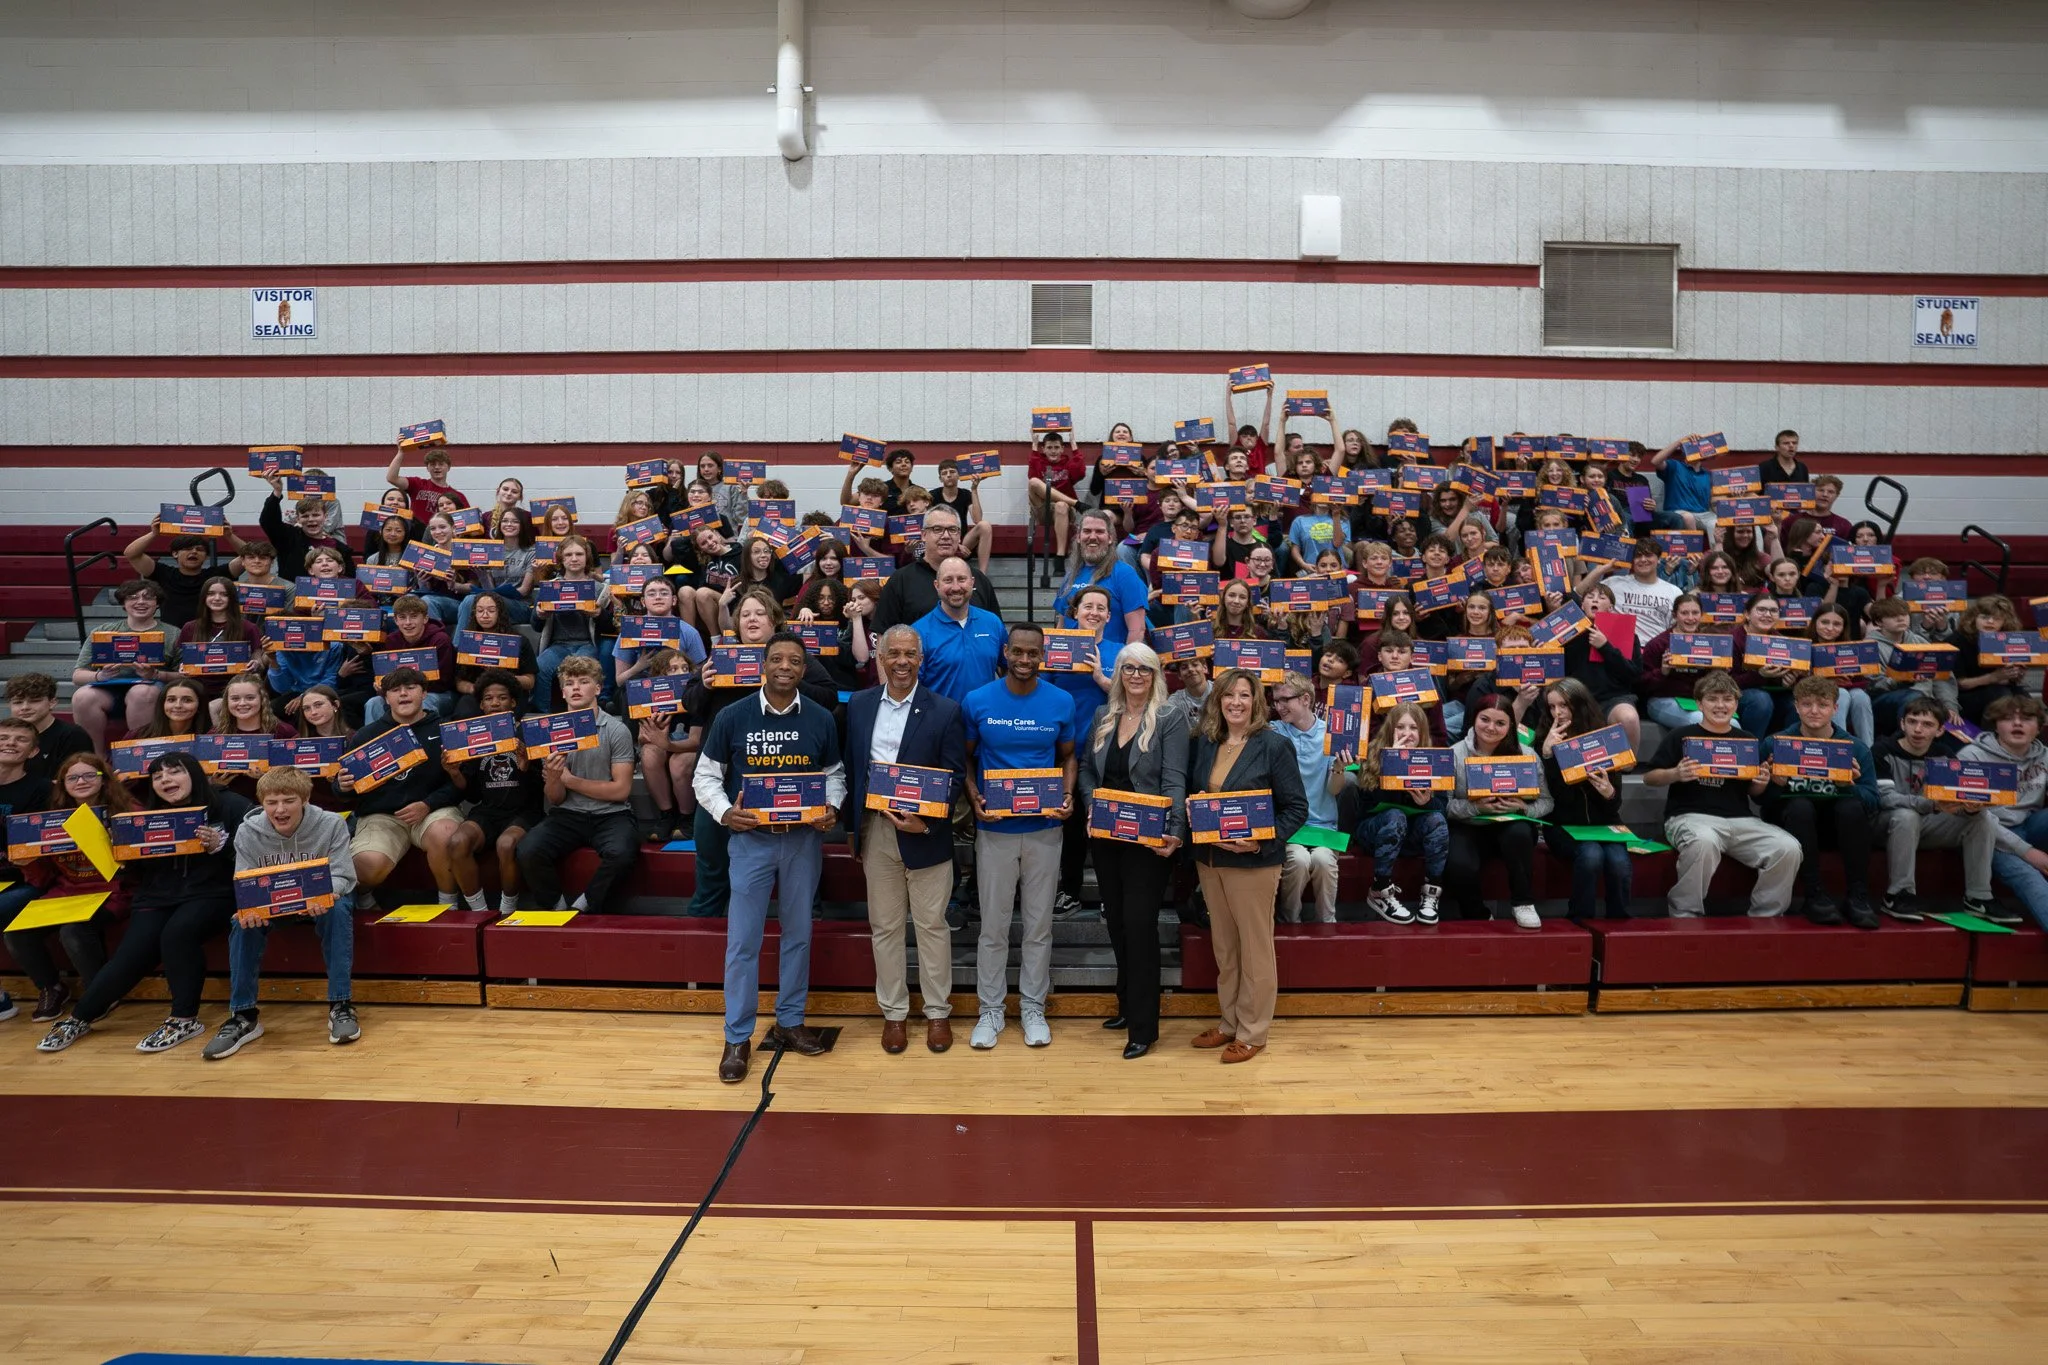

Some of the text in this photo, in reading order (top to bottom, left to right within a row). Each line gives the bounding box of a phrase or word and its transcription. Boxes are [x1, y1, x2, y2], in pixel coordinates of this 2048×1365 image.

[255, 290, 312, 301] VISITOR
[1917, 299, 1976, 309] STUDENT
[1624, 592, 1670, 607] WILDCATS
[987, 718, 1012, 726] Boeing
[746, 729, 799, 742] science
[747, 742, 782, 754] is for
[747, 755, 811, 768] everyone.
